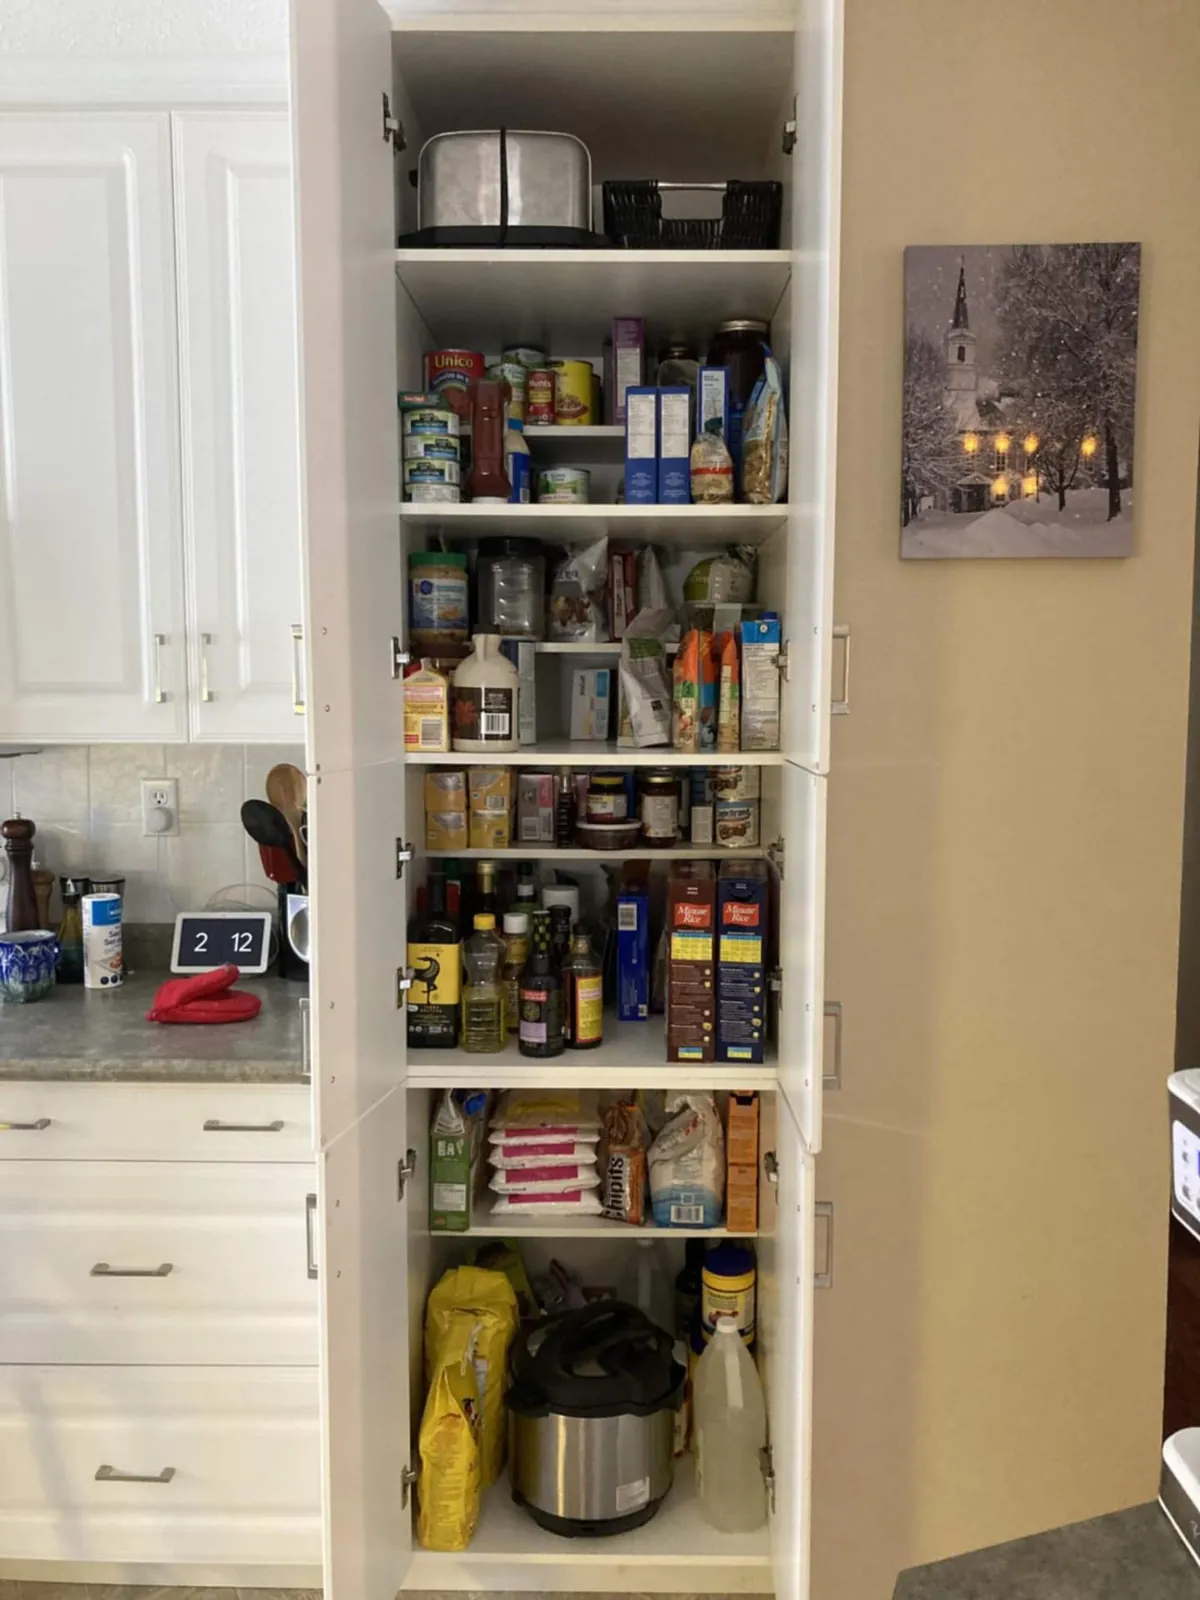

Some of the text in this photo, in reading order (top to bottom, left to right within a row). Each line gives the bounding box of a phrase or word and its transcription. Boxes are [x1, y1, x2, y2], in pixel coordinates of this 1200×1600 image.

[435, 355, 473, 368] Unico
[194, 932, 253, 952] 2 12
